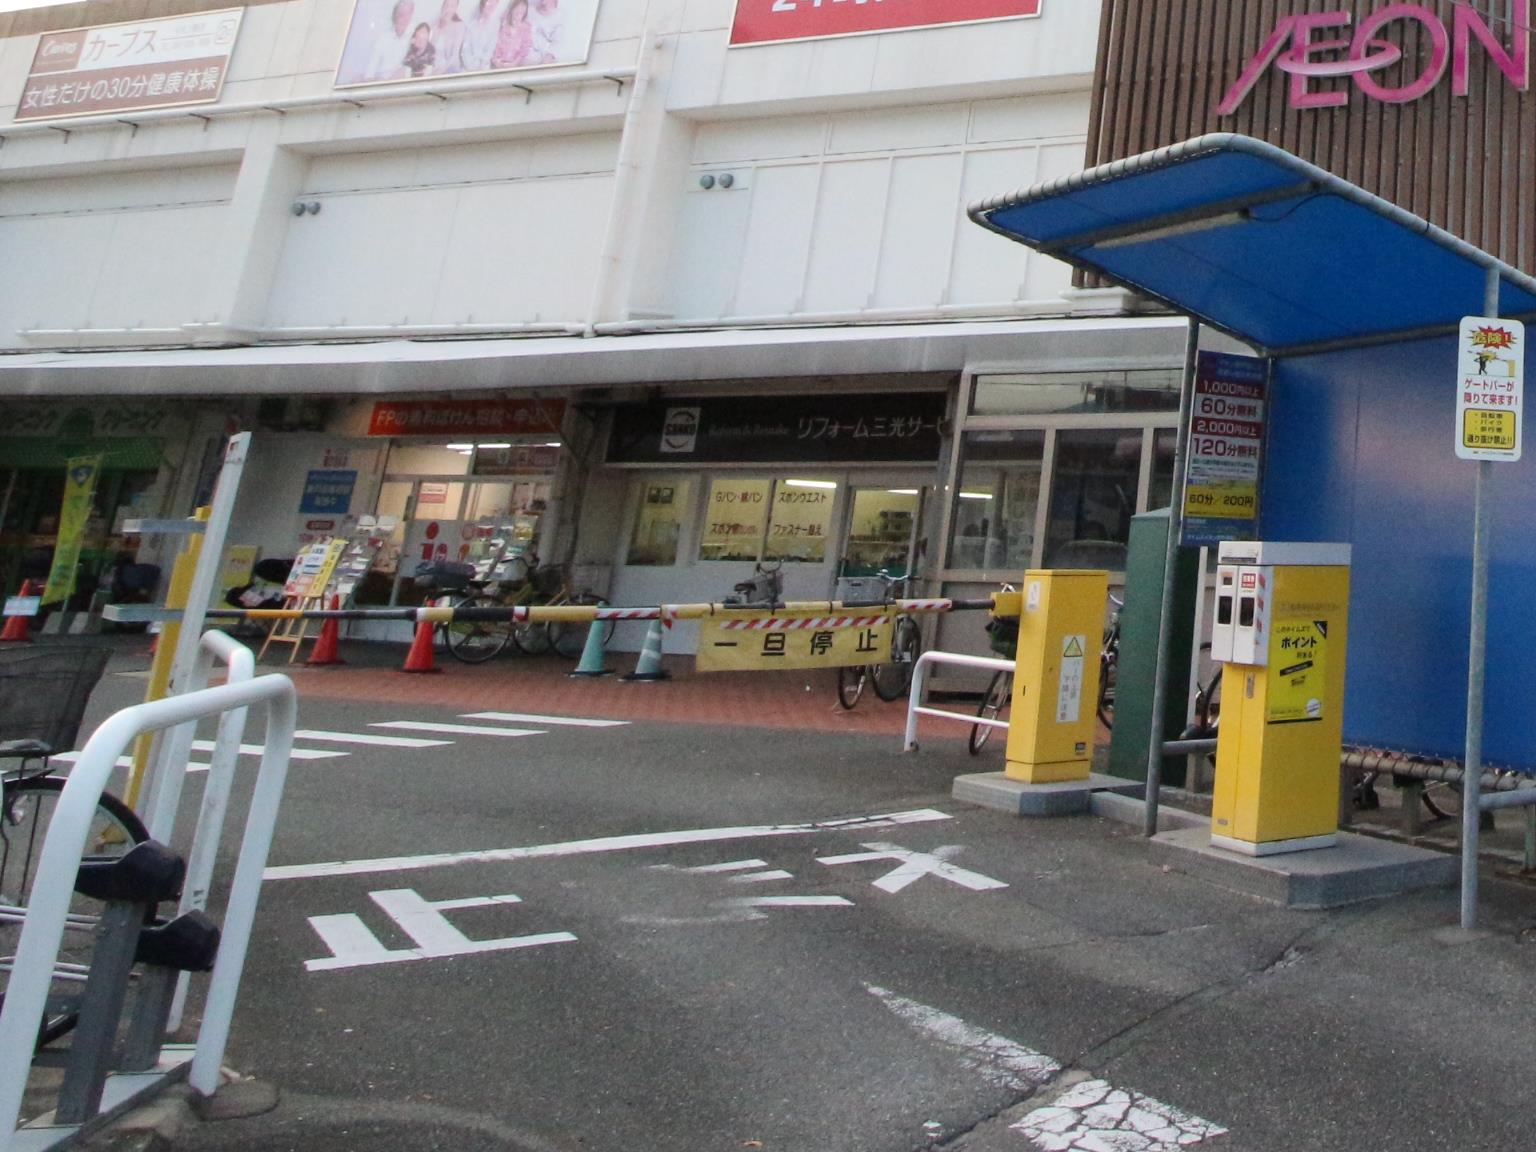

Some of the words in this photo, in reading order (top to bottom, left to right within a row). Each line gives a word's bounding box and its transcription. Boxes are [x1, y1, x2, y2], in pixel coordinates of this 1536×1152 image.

[22, 66, 221, 109] 女性だけの30分健康体操
[1464, 378, 1515, 392] ゲートバーが
[1201, 397, 1257, 418] 60分無料
[1193, 437, 1258, 458] 120分無料
[714, 629, 879, 657] 一旦停止
[1281, 636, 1318, 650] ポイント
